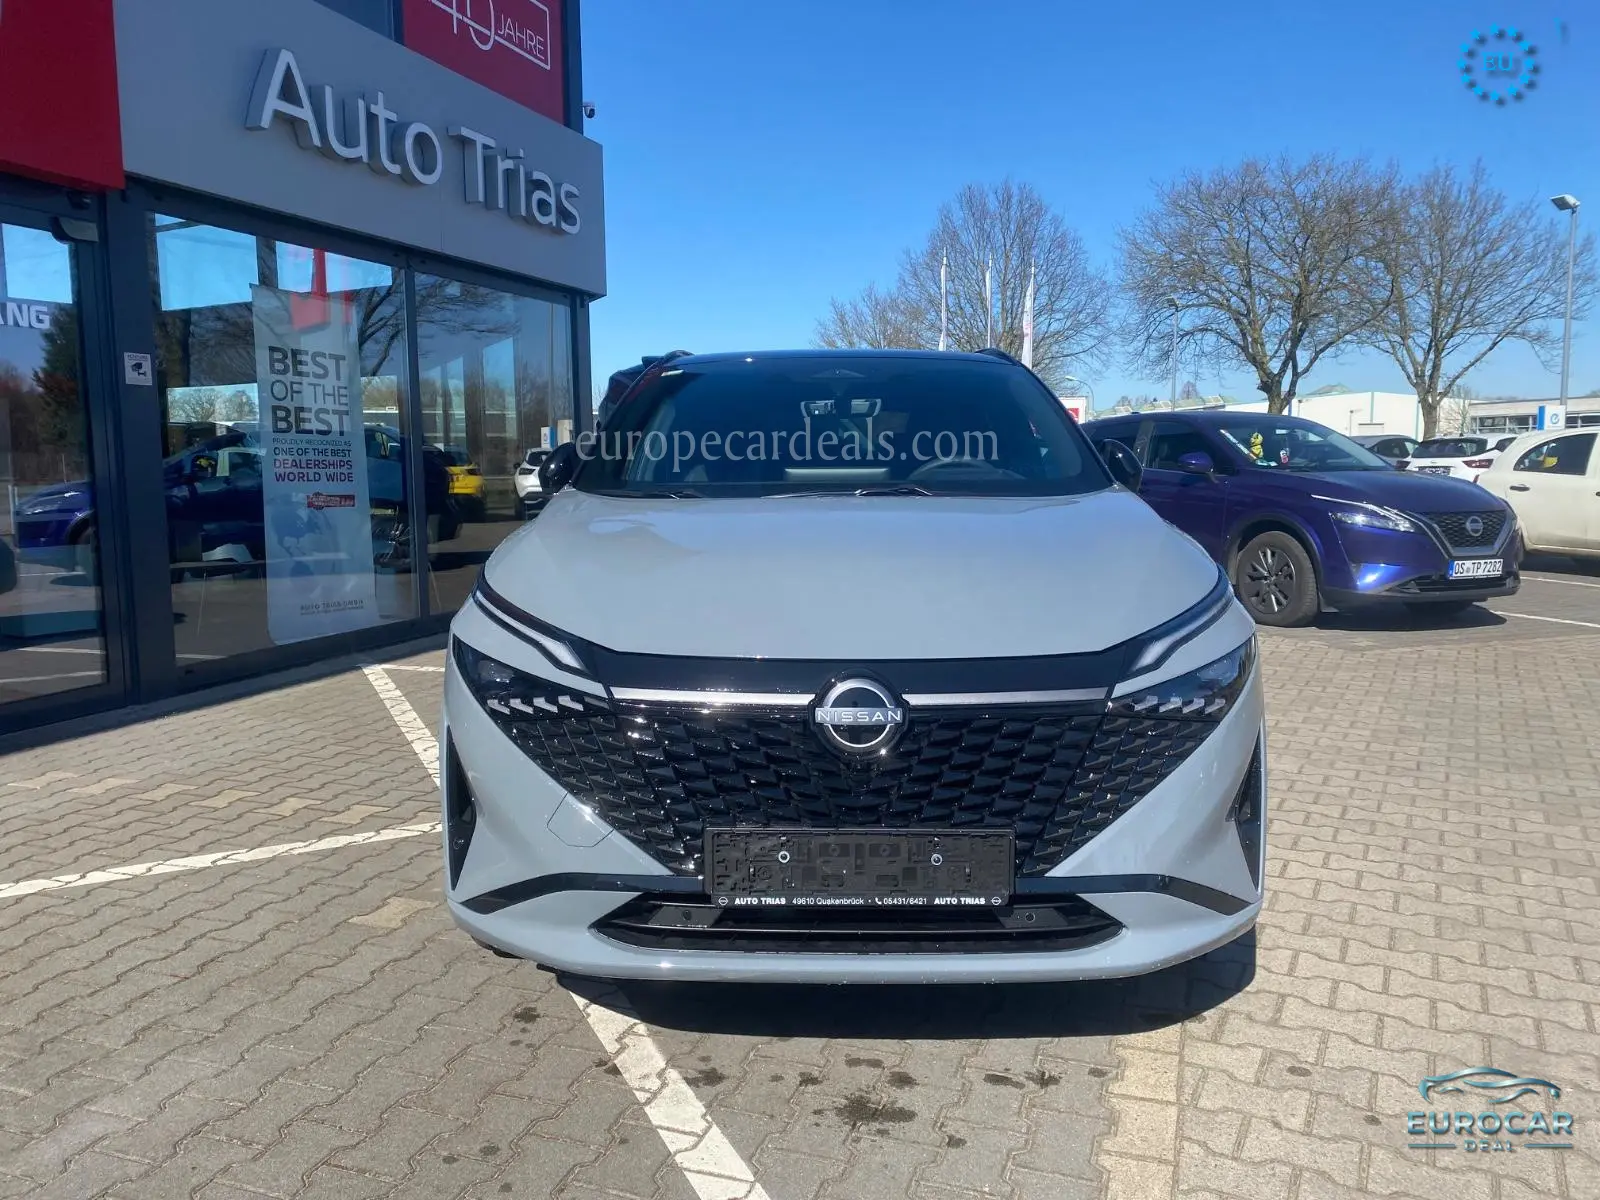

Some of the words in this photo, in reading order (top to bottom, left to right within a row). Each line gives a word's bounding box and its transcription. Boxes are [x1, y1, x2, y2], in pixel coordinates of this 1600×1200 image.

[497, 14, 545, 60] JAHRE
[248, 49, 443, 186] Auto
[449, 126, 582, 236] Trias
[268, 345, 346, 381] BEST
[270, 379, 303, 402] OF
[307, 382, 348, 406] THE
[271, 404, 350, 436] BEST
[273, 446, 295, 456] ONE
[296, 447, 310, 456] OF
[312, 447, 330, 457] THE
[330, 449, 352, 458] BEST
[274, 458, 353, 470] DEALERSHIPS
[275, 471, 321, 482] WORLD
[325, 471, 354, 482] WIDE
[1454, 562, 1465, 575] OS
[1471, 562, 1482, 574] TP
[1482, 560, 1502, 573] 7282
[816, 708, 902, 723] NISSAN
[734, 896, 757, 905] AUTO
[760, 896, 786, 905] TRIAS
[792, 896, 815, 905] 49610
[816, 896, 864, 906] Quakenbrück
[933, 896, 957, 905] AUTO
[960, 896, 986, 905] TRIAS
